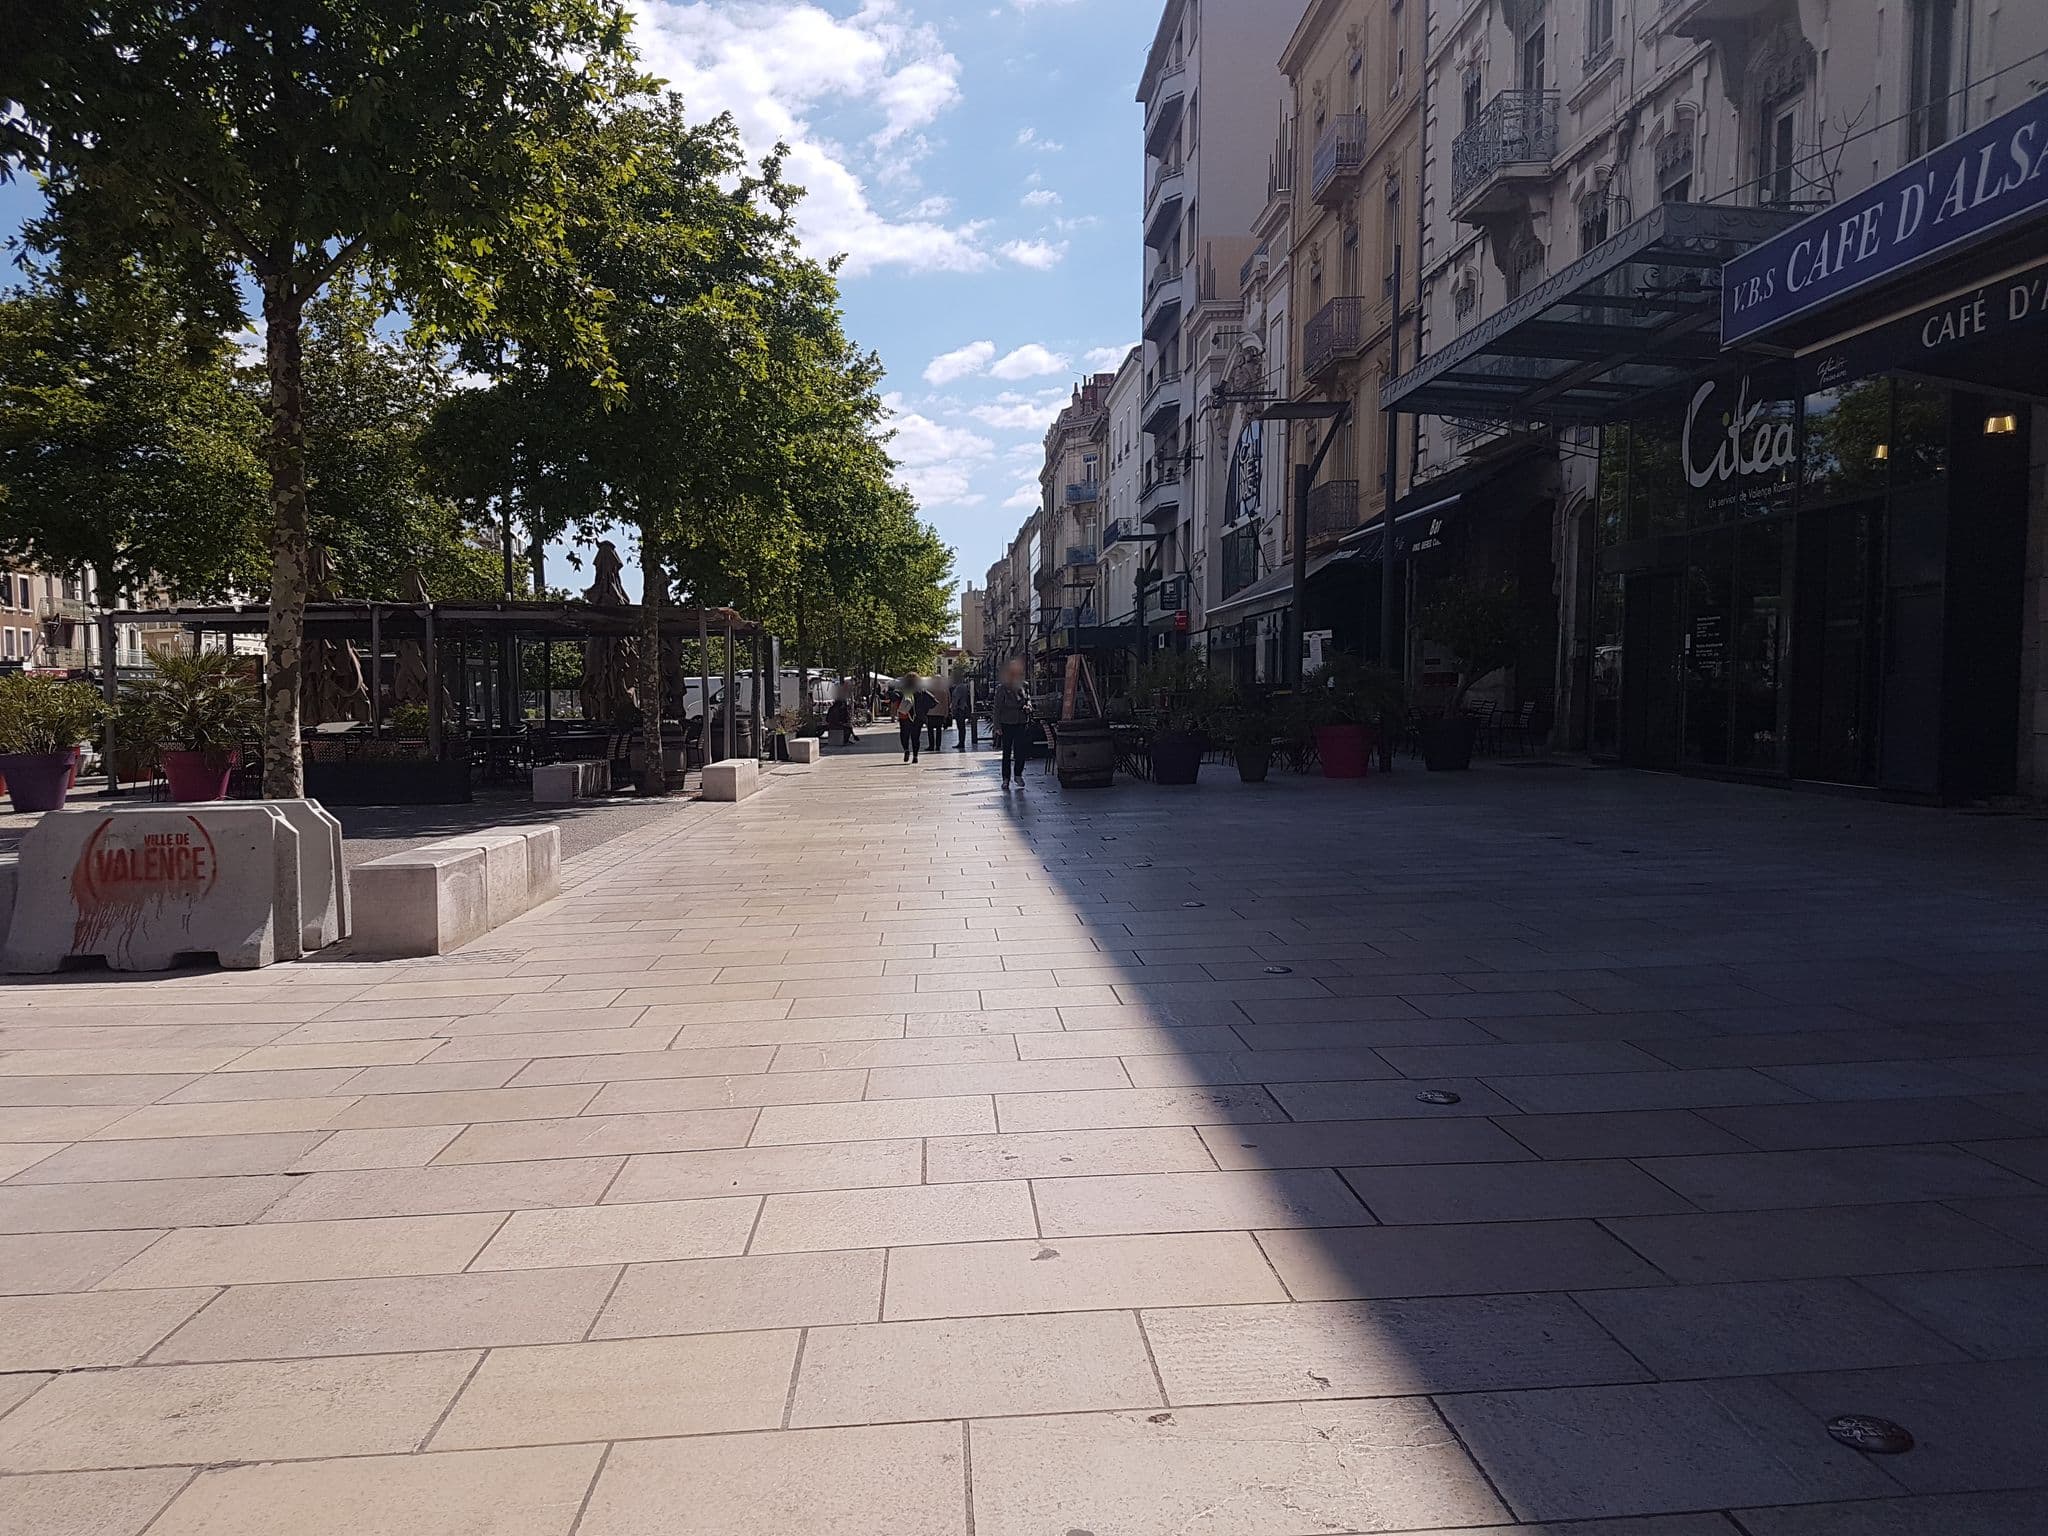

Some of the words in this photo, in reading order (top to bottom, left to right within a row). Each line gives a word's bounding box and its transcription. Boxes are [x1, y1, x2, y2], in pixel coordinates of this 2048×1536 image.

[1733, 267, 1776, 314] V.B.S
[1786, 202, 1884, 293] CAFE
[1922, 289, 1986, 348] CAFÉ
[1682, 375, 1796, 488] Citea
[96, 846, 206, 882] VALENCE
[144, 833, 176, 846] VILLE
[176, 833, 190, 845] DE
